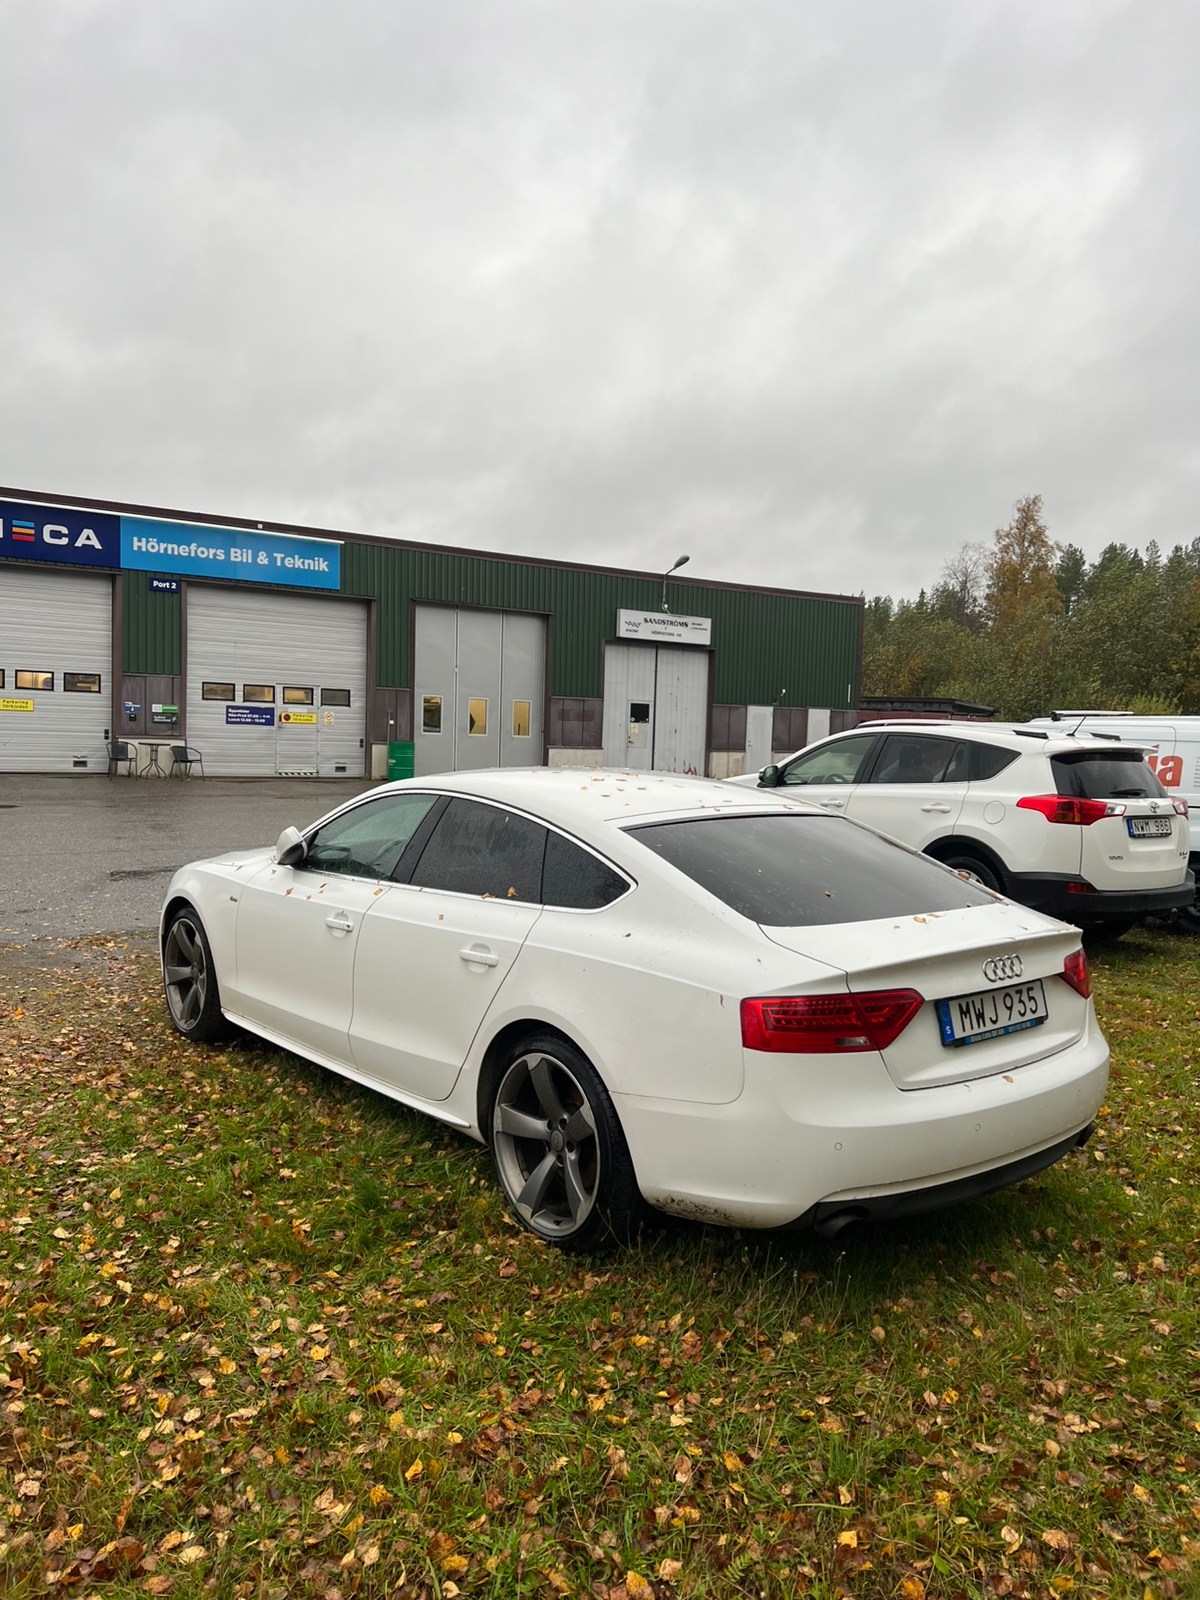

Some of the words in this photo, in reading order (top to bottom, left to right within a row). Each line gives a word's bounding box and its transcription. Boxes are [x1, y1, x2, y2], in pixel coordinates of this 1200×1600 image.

[0, 518, 103, 550] ECA
[132, 536, 225, 561] Hörnefors
[229, 547, 253, 564] Bil
[256, 550, 269, 565] &
[273, 552, 329, 572] Teknik
[152, 579, 170, 589] Port
[170, 581, 177, 590] 2
[643, 617, 688, 628] SANDSTRÖMS
[1133, 820, 1151, 833] NWM
[958, 995, 999, 1033] MWJ
[1003, 986, 1038, 1021] 935
[945, 1026, 951, 1034] S
